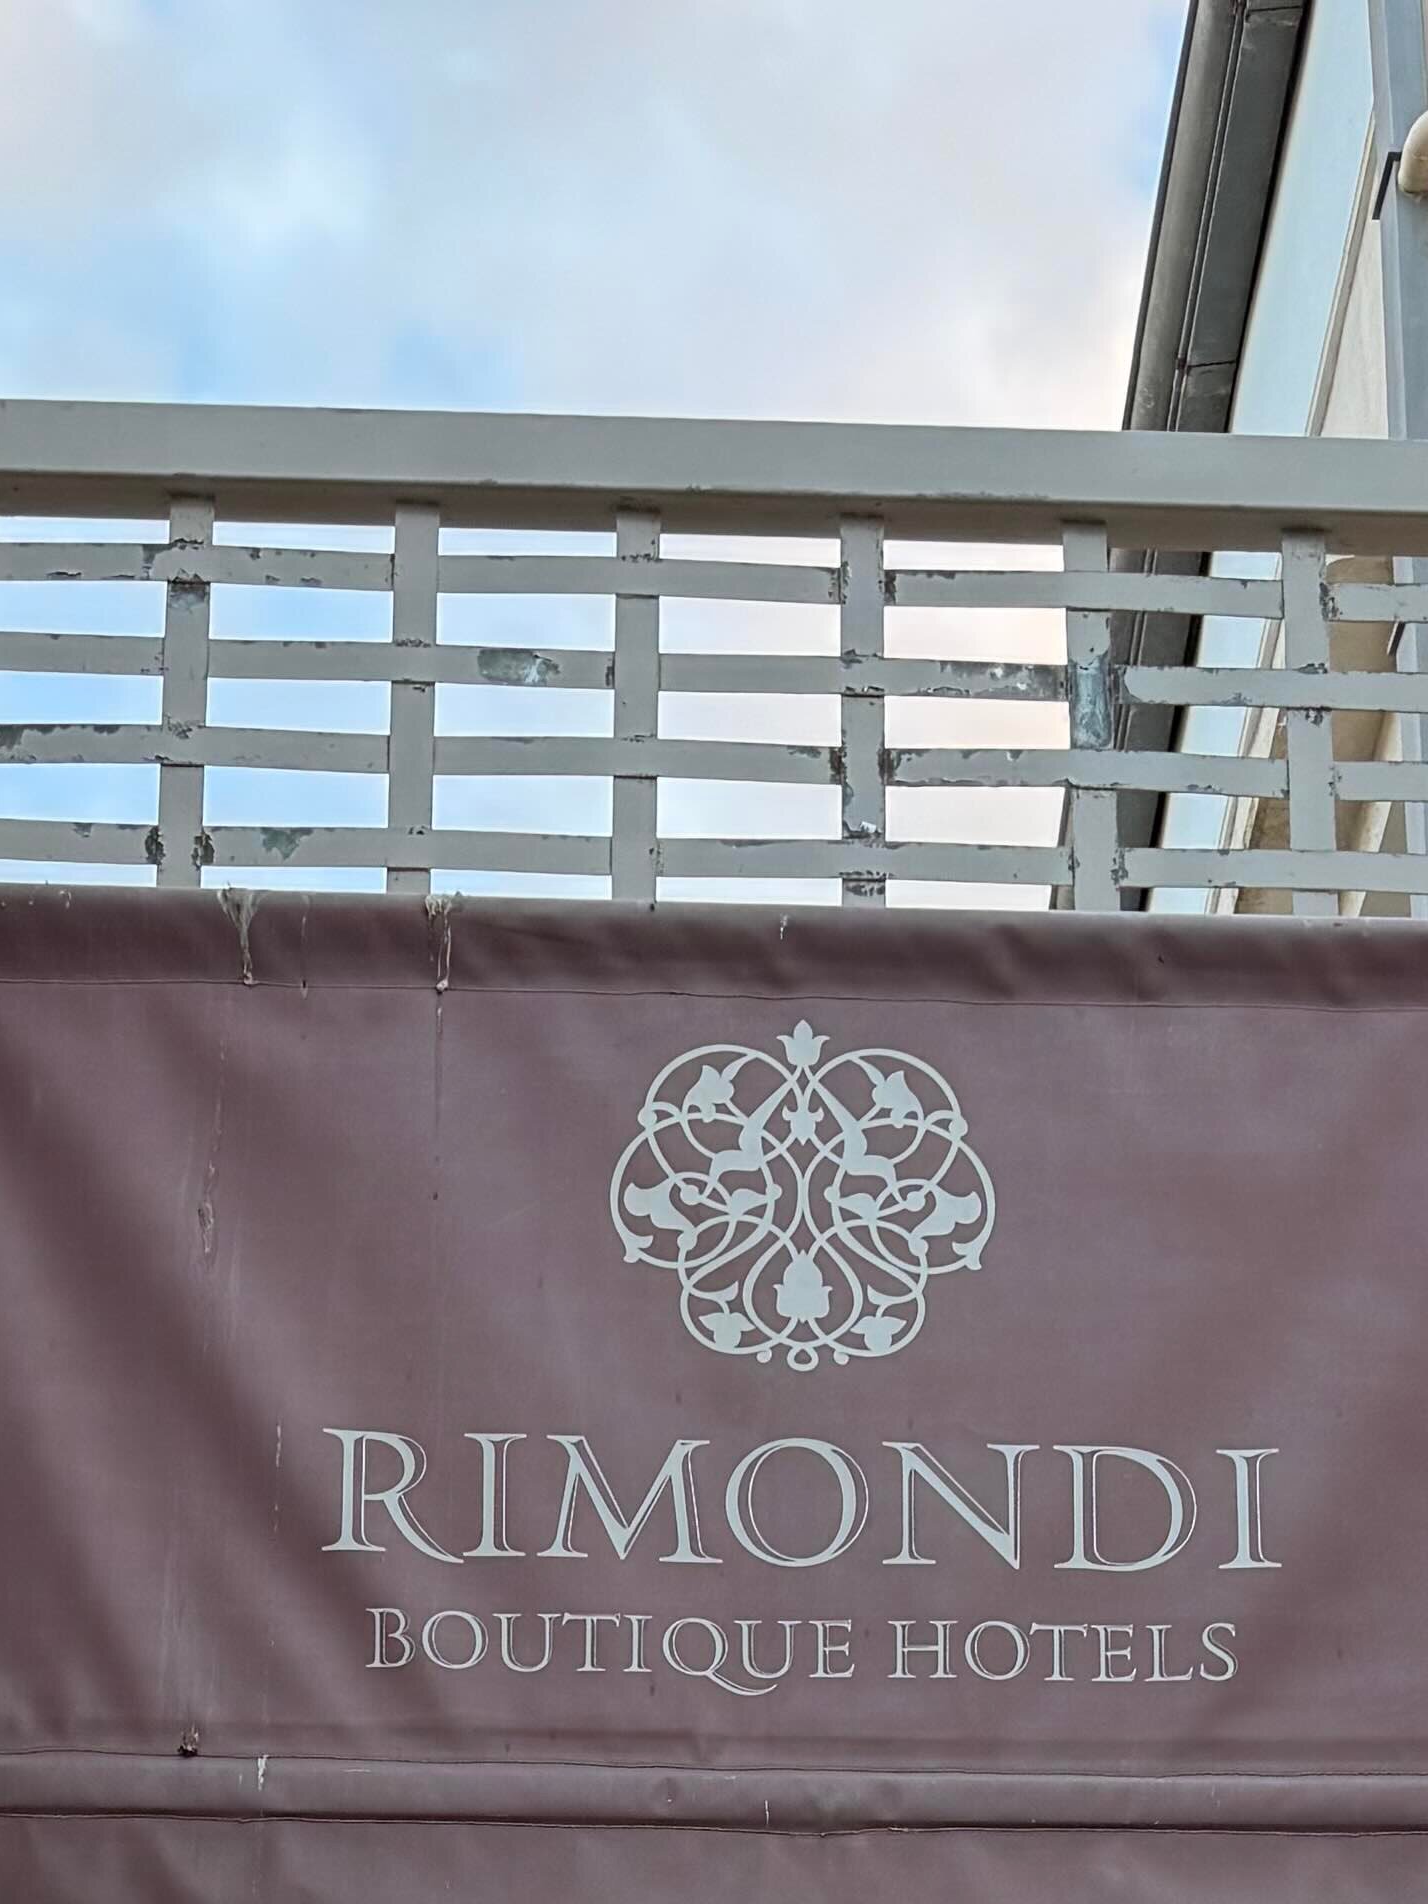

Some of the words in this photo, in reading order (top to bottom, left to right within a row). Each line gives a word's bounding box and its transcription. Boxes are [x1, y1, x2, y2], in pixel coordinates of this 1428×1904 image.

[321, 1427, 1283, 1572] RIMONDI
[365, 1606, 856, 1696] BOUTIQUE
[888, 1619, 1239, 1684] HOTELS
